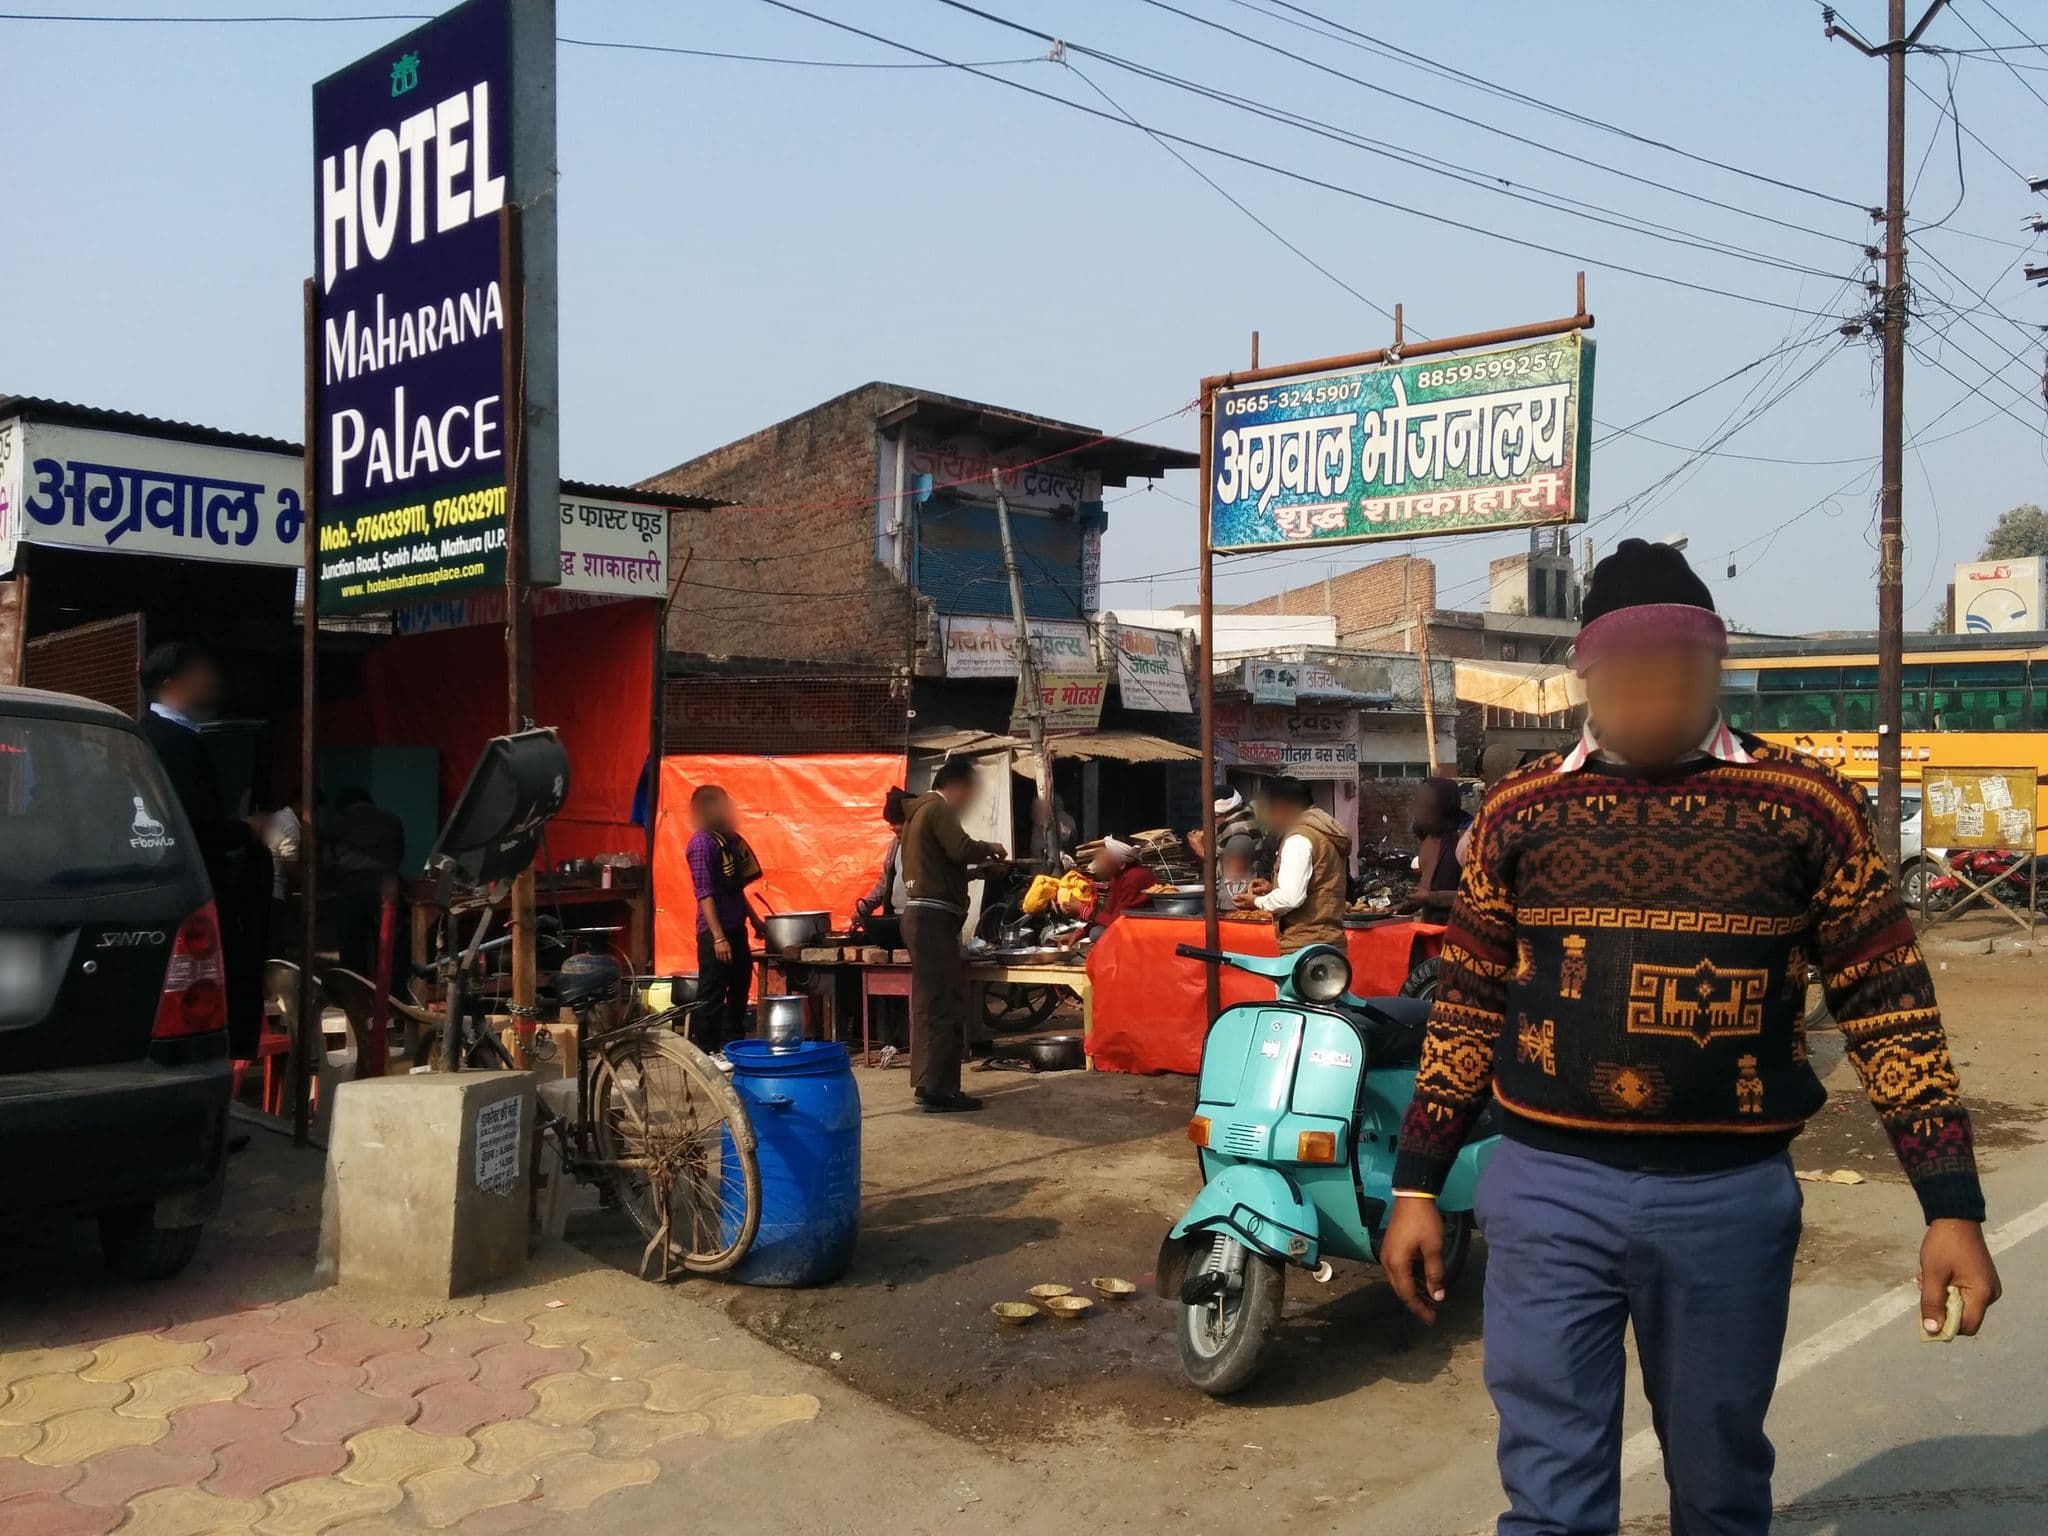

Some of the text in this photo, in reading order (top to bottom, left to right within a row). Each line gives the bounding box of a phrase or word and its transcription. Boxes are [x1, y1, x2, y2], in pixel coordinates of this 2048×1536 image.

[323, 80, 505, 296] HOTEL
[1418, 350, 1564, 389] 8859599257
[1225, 382, 1361, 415] 0565-3245907
[1217, 373, 1571, 517] अग्रवाल भोजनालय
[25, 458, 265, 546] अग्रवाल
[320, 504, 430, 552] Mob.-9760339111,
[433, 486, 507, 529] 976032911
[578, 504, 628, 531] फास्ट
[631, 511, 662, 543] फूड
[1274, 472, 1564, 538] शुद्ध शाकाहारी
[321, 558, 355, 580] Junction
[356, 552, 381, 573] Road,
[441, 535, 482, 558] Mathura
[582, 549, 661, 584] शाकाहारी
